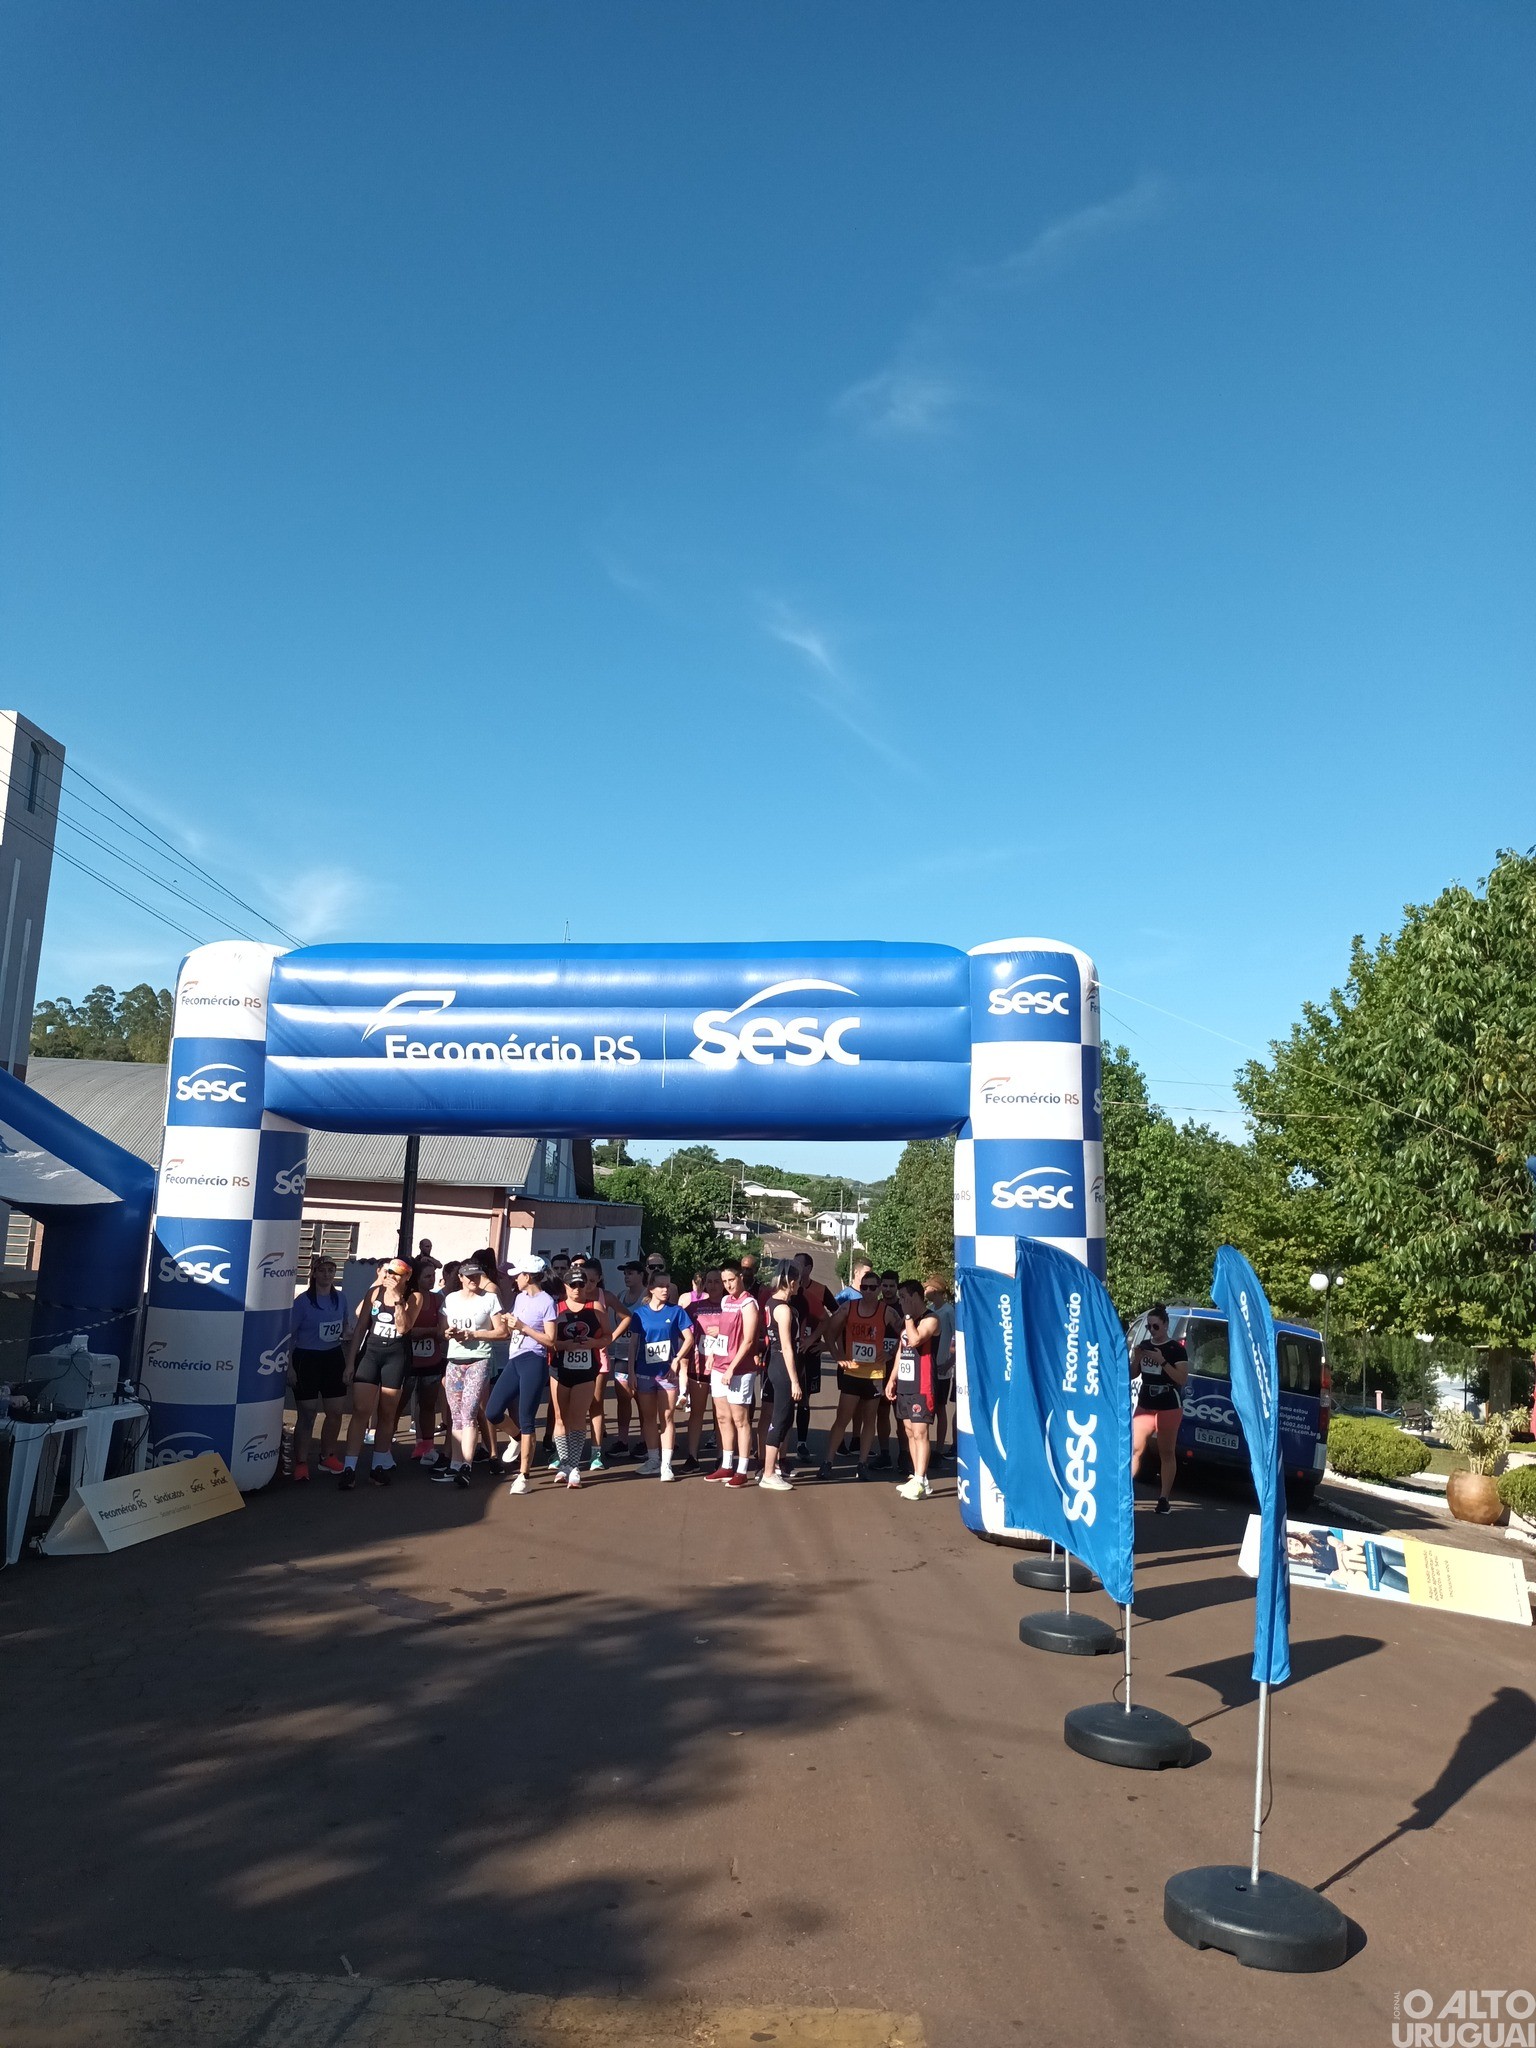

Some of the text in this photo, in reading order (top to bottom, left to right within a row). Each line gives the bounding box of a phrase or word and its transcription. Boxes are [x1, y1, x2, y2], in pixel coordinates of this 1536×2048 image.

[181, 995, 262, 1009] Fecomércio RS
[987, 986, 1070, 1016] Sesc
[385, 1008, 860, 1067] Fecomércio RS Sesc
[176, 1075, 247, 1103] Sesc
[985, 1091, 1080, 1105] Fecomércio RS
[165, 1173, 251, 1188] Fecomércio RS
[990, 1179, 1074, 1210] Sesc
[158, 1256, 232, 1285] Sesc
[323, 1323, 341, 1336] 792
[414, 1340, 432, 1351] 713
[647, 1344, 667, 1357] 944
[855, 1345, 874, 1358] 730
[1063, 1292, 1082, 1393] Fecomércio
[148, 1356, 234, 1371] Fecomércio RS
[567, 1351, 588, 1363] 858
[1142, 1356, 1160, 1368] 994
[1085, 1340, 1100, 1397] Senac
[1182, 1398, 1235, 1426] Sesc
[1062, 1409, 1098, 1528] Sesc
[98, 1500, 138, 1521] Fecomércio
[138, 1499, 148, 1509] RS
[153, 1489, 185, 1504] Sindicatos
[190, 1482, 205, 1493] Sesc
